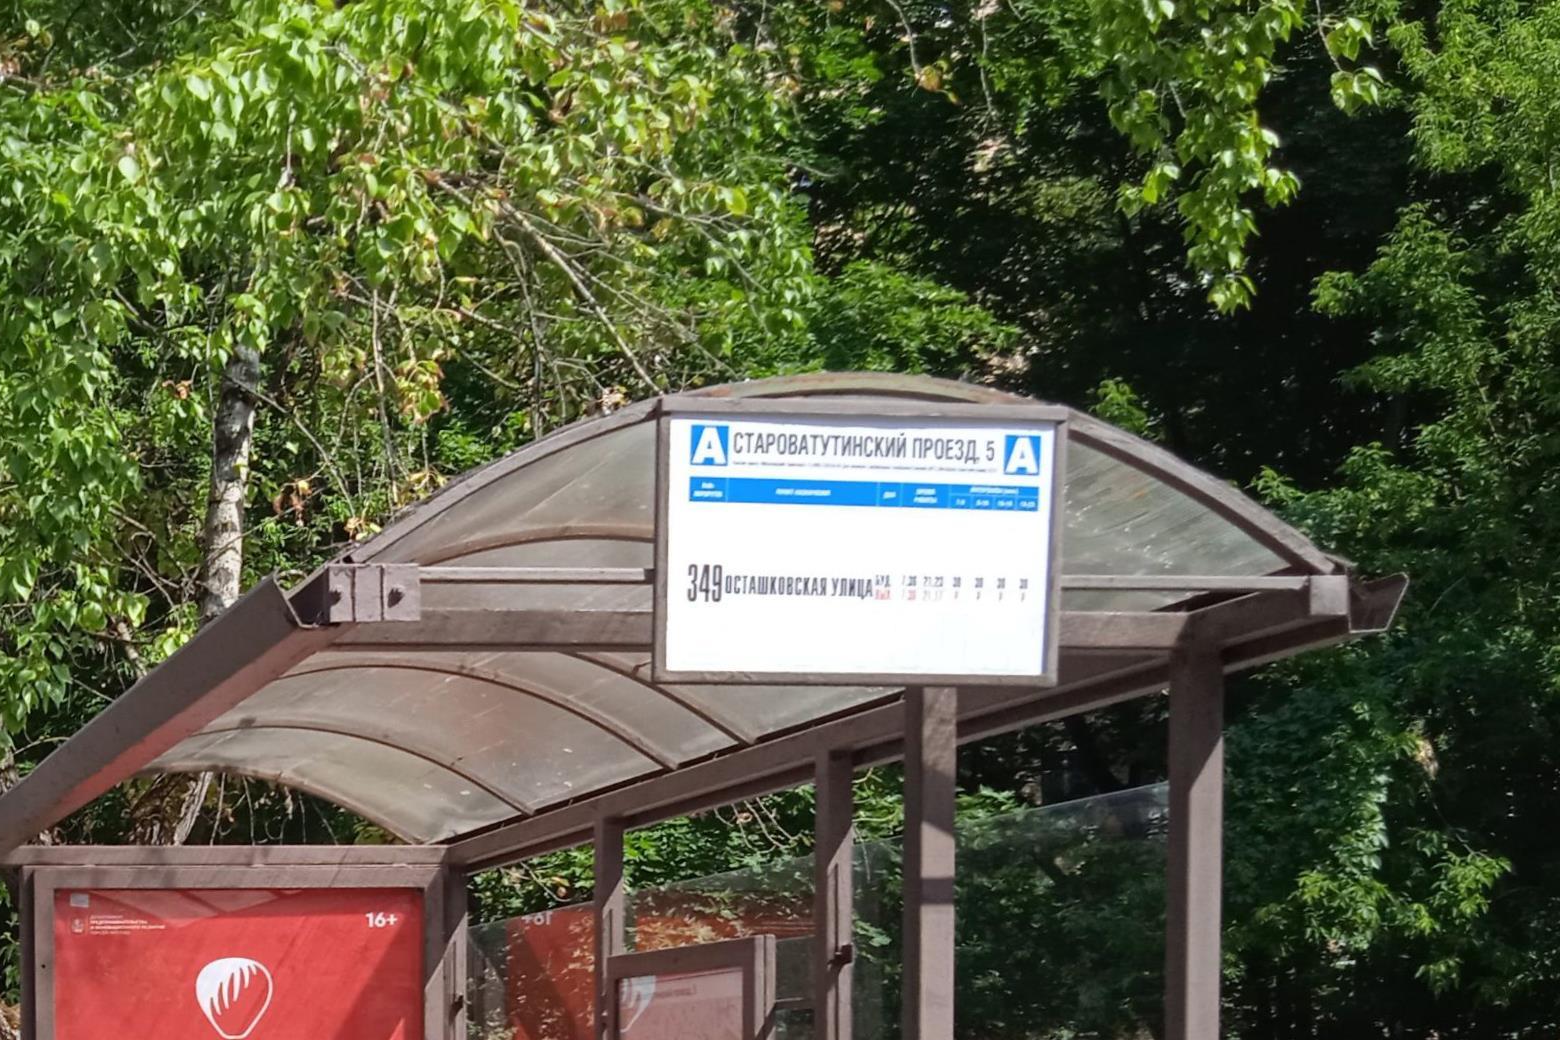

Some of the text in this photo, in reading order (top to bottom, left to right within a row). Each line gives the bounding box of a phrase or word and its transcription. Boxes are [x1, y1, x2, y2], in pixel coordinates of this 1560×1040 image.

[733, 432, 907, 459] СТАРОВАТУТИНСКИЙ
[985, 440, 996, 462] 5
[687, 563, 723, 602] 349
[724, 574, 828, 597] ОСТАШКОВСКАЯ
[831, 577, 874, 601] УЛИЦА
[365, 911, 398, 928] 16+
